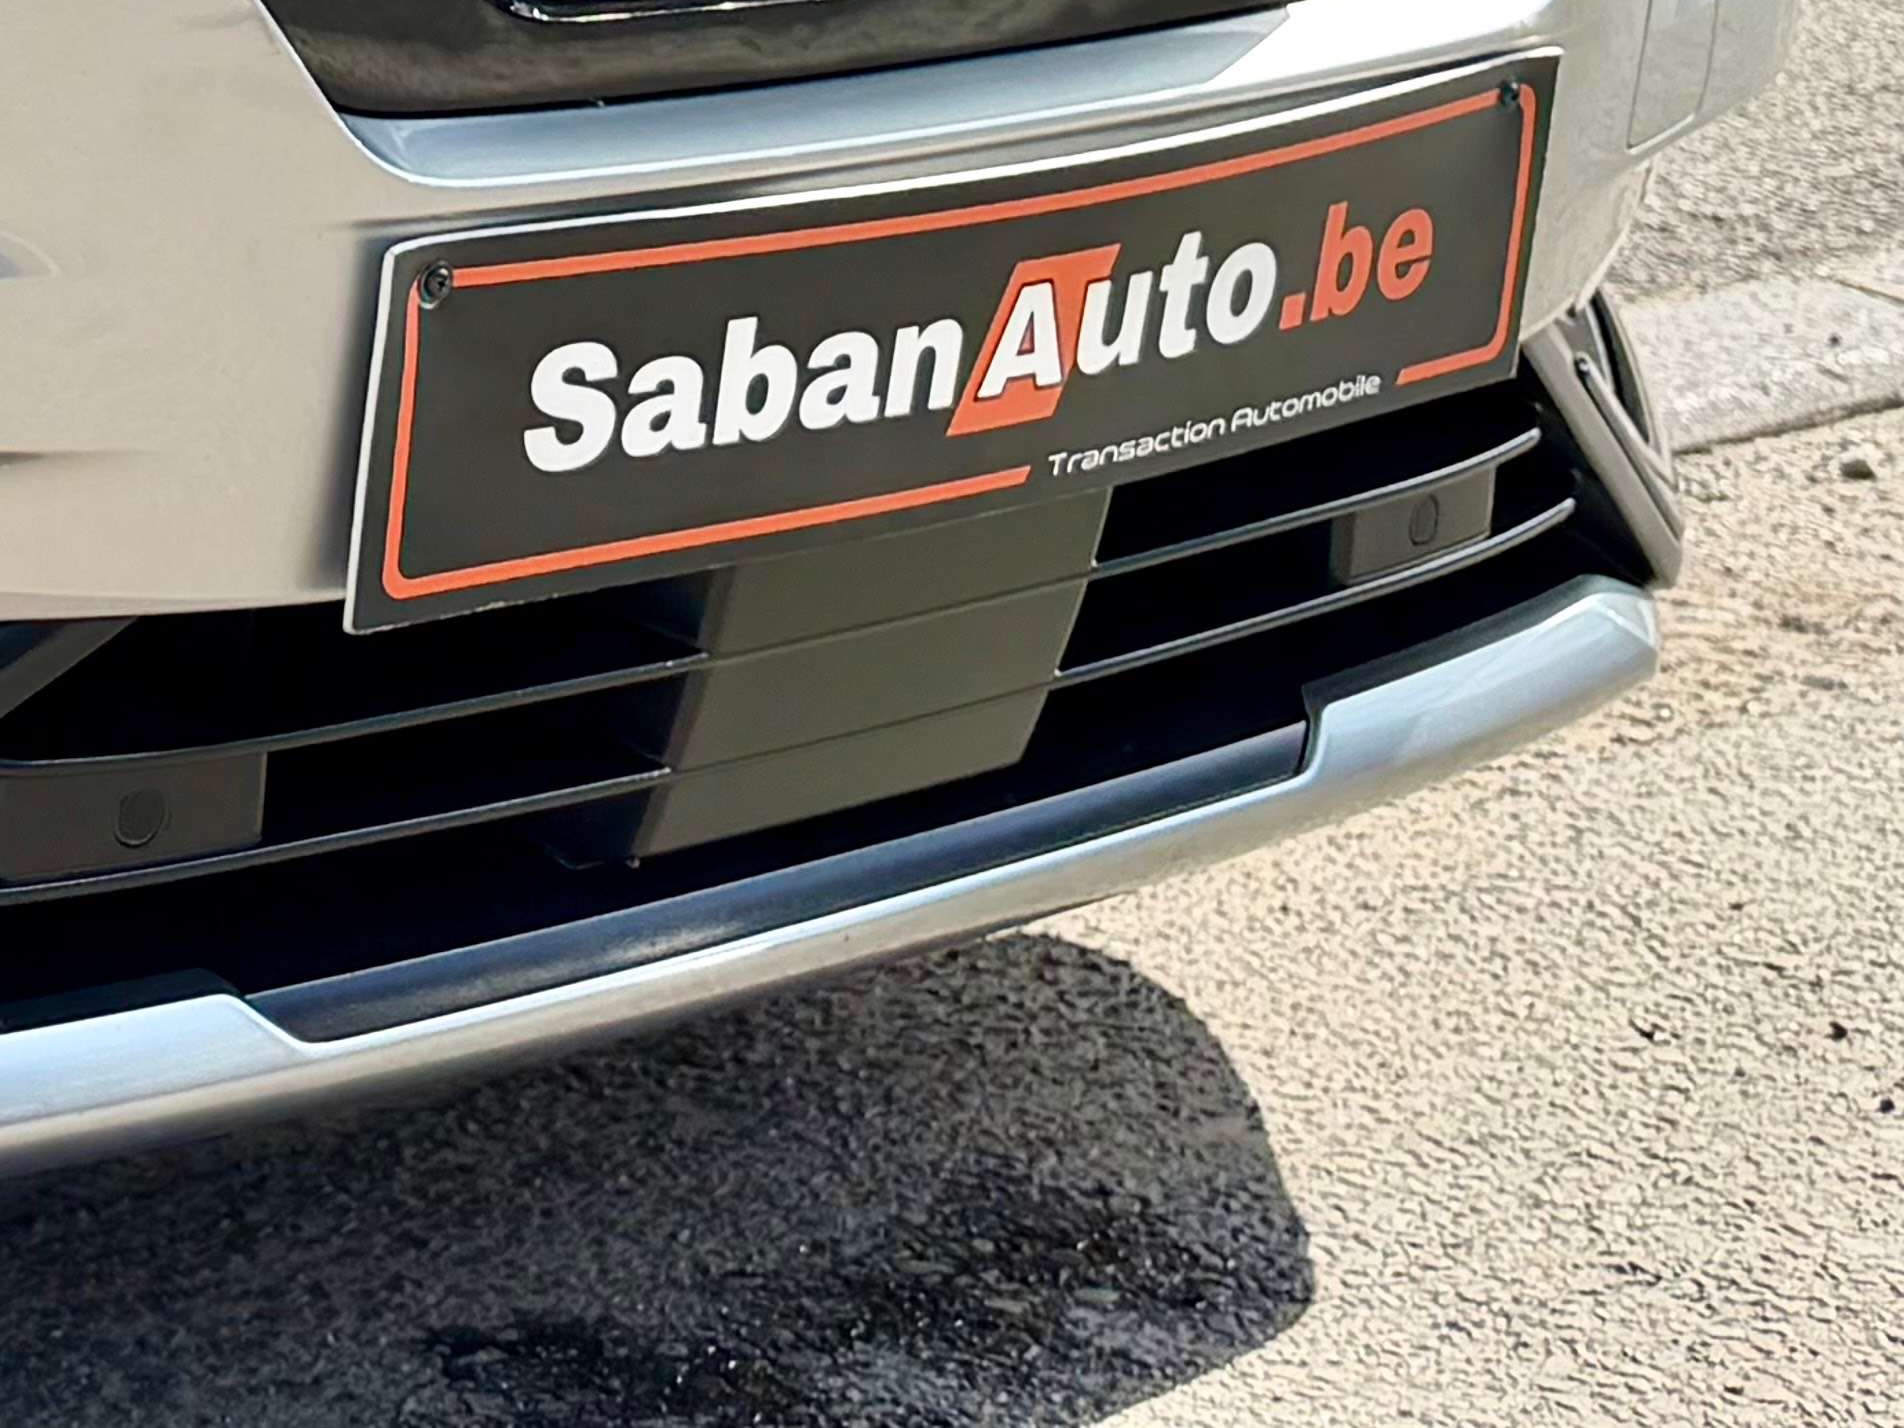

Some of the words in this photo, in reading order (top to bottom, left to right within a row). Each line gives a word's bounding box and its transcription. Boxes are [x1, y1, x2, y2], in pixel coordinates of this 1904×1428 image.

[523, 201, 1433, 474] SabanAuto.be
[1047, 419, 1226, 477] Transaction
[1230, 374, 1383, 433] Automobile
